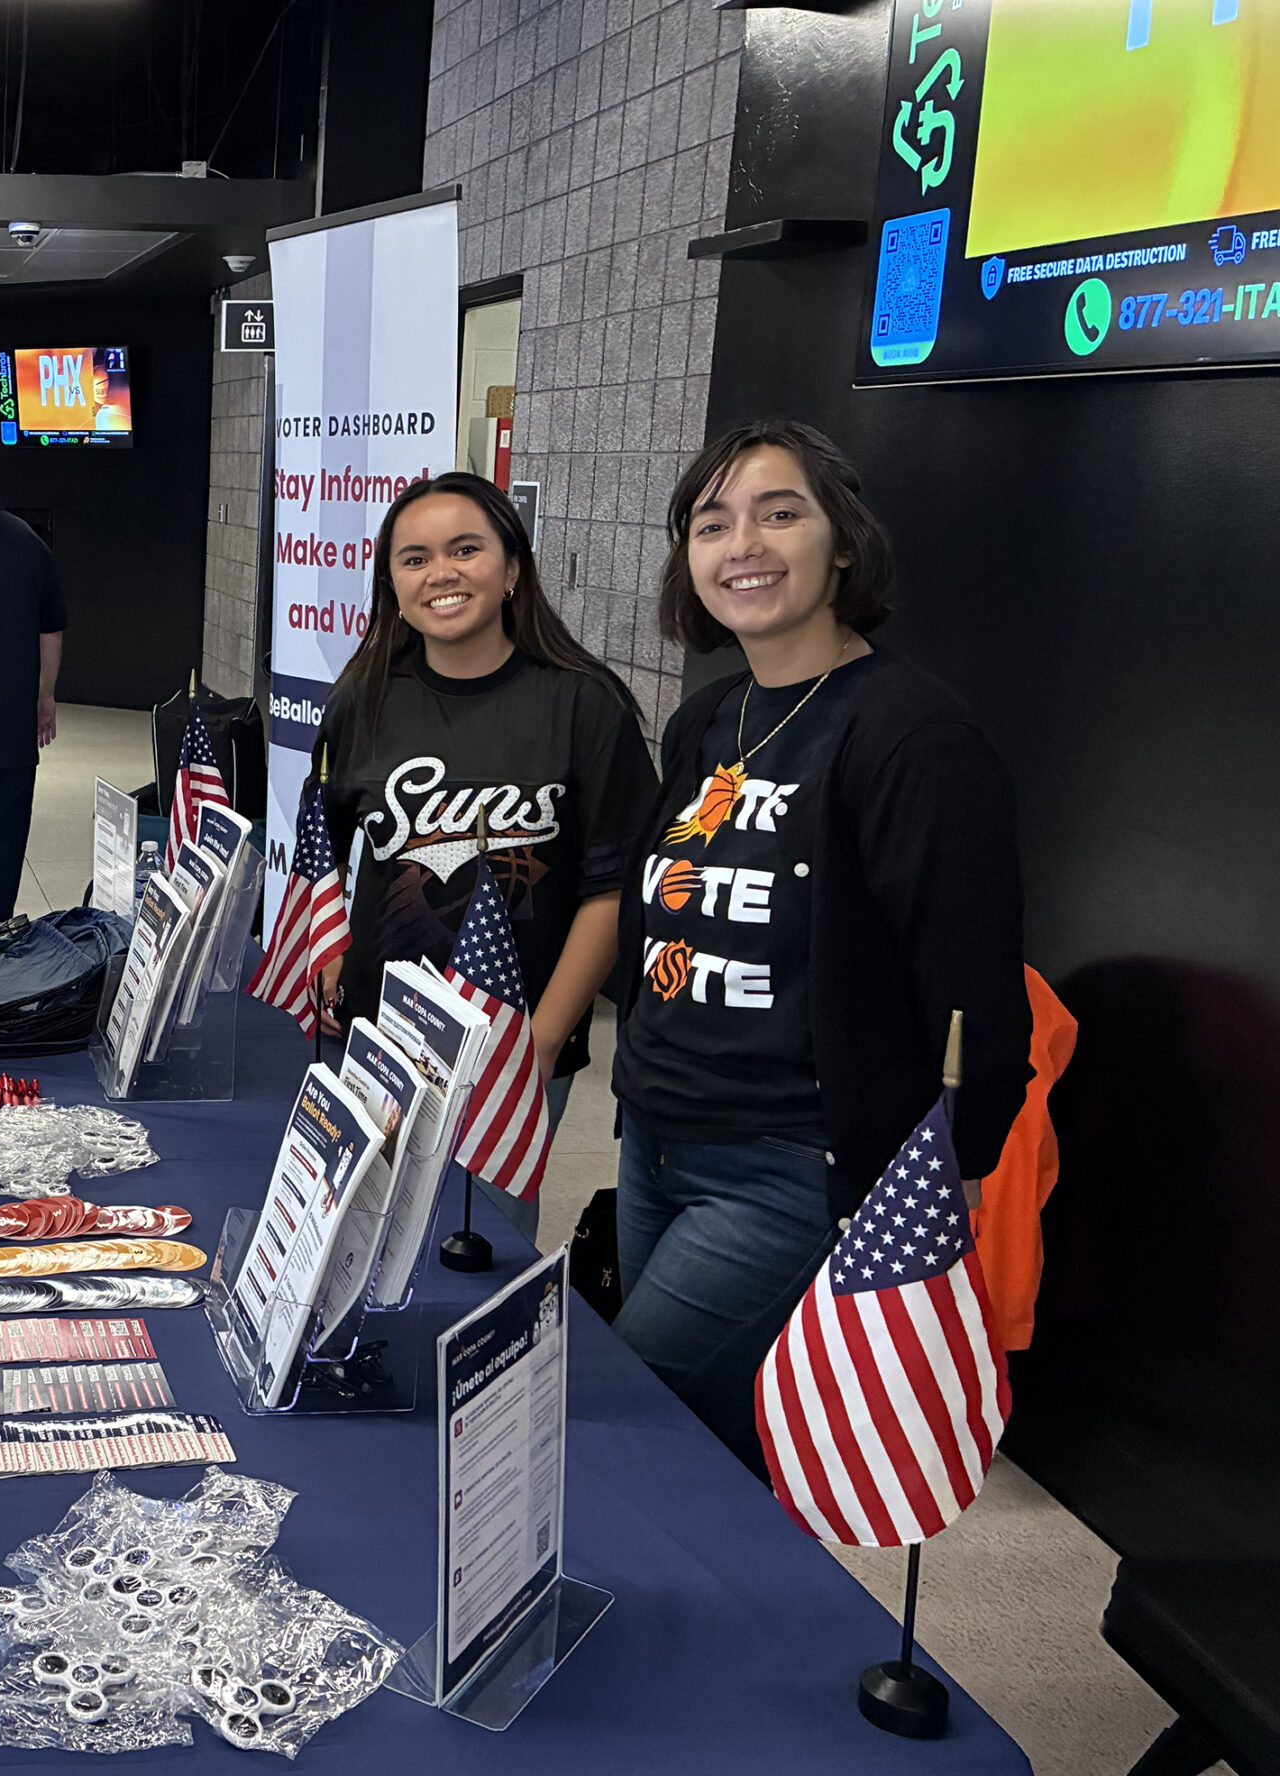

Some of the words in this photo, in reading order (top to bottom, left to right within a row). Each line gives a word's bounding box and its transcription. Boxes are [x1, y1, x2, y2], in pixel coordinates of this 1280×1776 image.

[1251, 229, 1280, 250] FRE
[1007, 265, 1033, 284] FREE
[1033, 258, 1075, 279] SECURE
[1075, 252, 1104, 273] DATA
[1105, 243, 1187, 270] DESTRUCTION
[39, 354, 87, 407] PHX
[328, 412, 435, 437] DASHBOARD
[274, 467, 315, 512] Stay
[277, 532, 337, 568] Make
[342, 542, 356, 570] a
[289, 600, 335, 633] and
[340, 602, 372, 639] Vo
[269, 691, 326, 727] BeBallo
[365, 756, 566, 861] Suns
[305, 1081, 318, 1100] Are
[316, 1090, 331, 1112] You
[301, 1094, 321, 1120] Ballot
[319, 1111, 341, 1143] Ready?
[485, 1357, 494, 1377] al
[494, 1330, 528, 1369] equipo!
